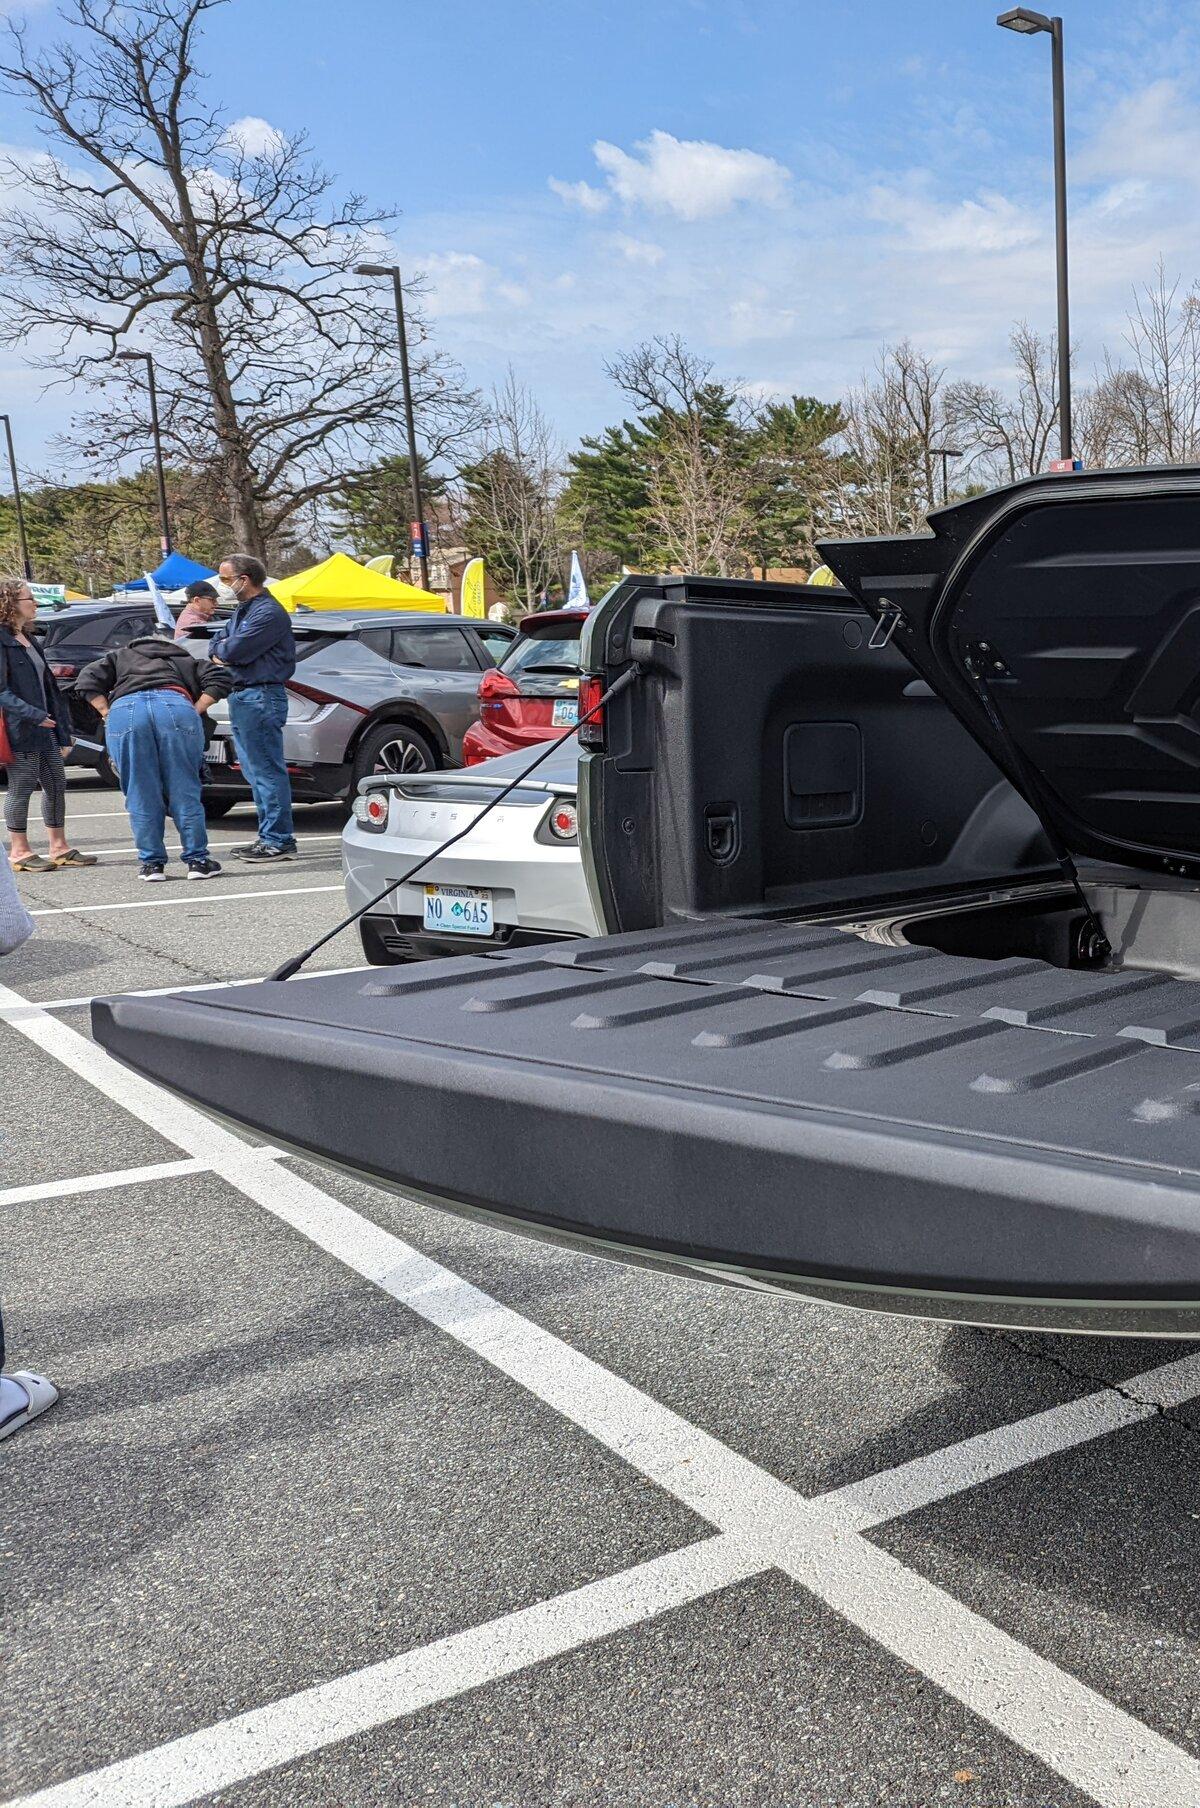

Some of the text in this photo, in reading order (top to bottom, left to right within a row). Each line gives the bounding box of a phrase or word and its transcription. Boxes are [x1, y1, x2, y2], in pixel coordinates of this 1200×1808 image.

[31, 586, 61, 595] RIVE
[412, 810, 505, 822] TESA
[441, 888, 474, 898] VIRGINIA
